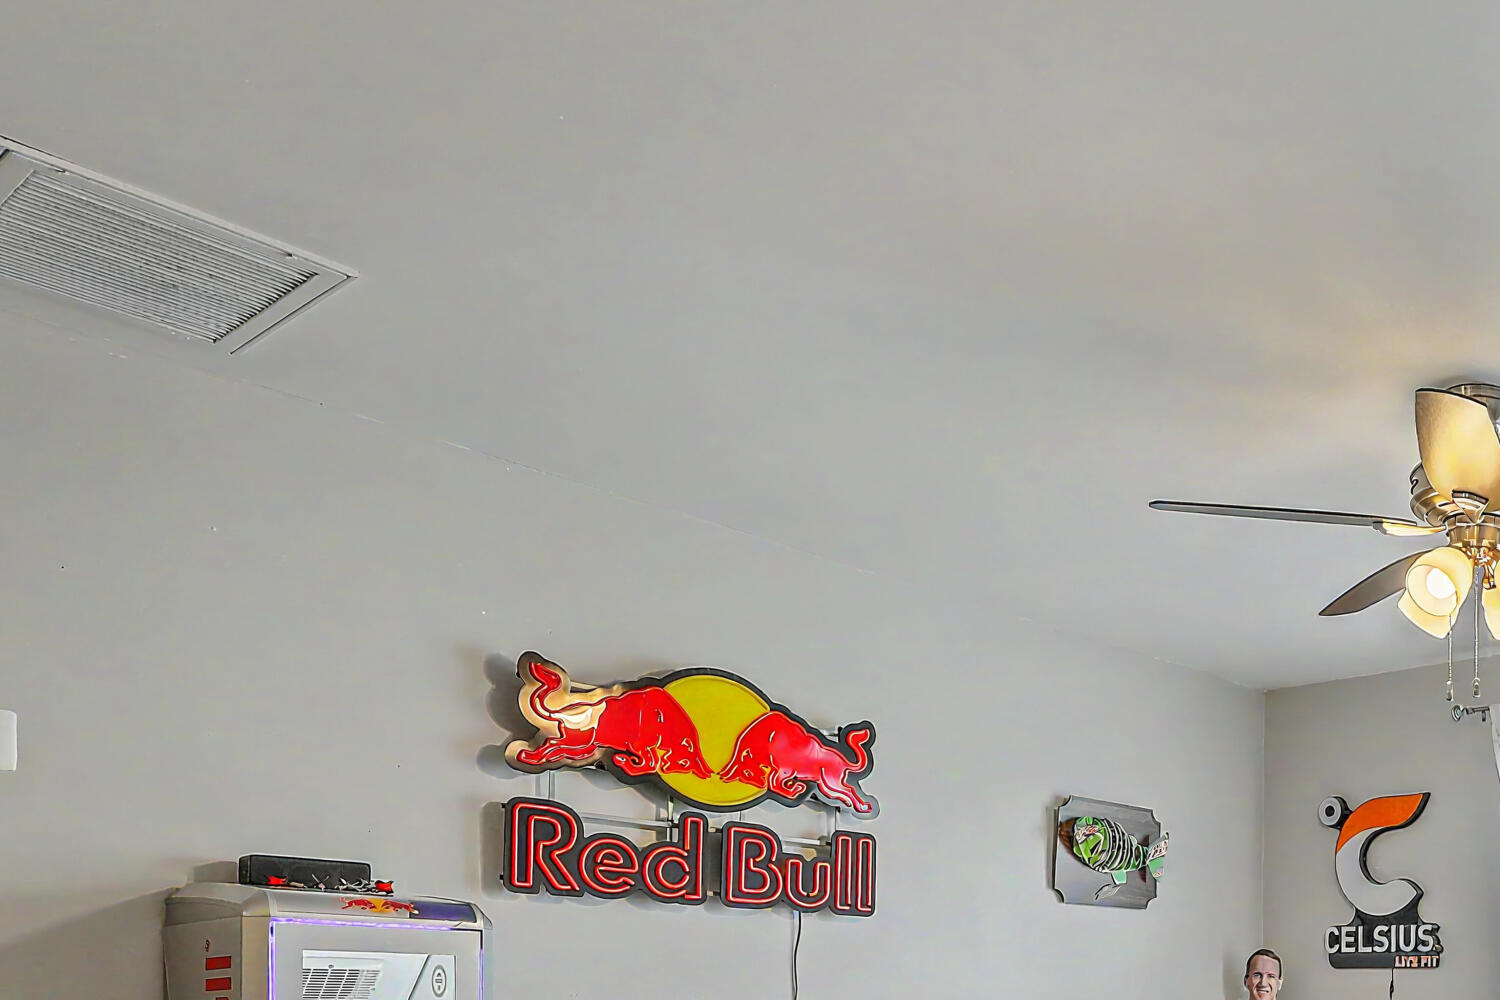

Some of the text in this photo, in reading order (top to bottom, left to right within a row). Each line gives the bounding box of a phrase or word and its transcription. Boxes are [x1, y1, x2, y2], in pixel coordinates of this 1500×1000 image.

[511, 802, 873, 913] Red Bull
[1325, 924, 1434, 953] CELSIUS
[1420, 955, 1439, 968] FIT
